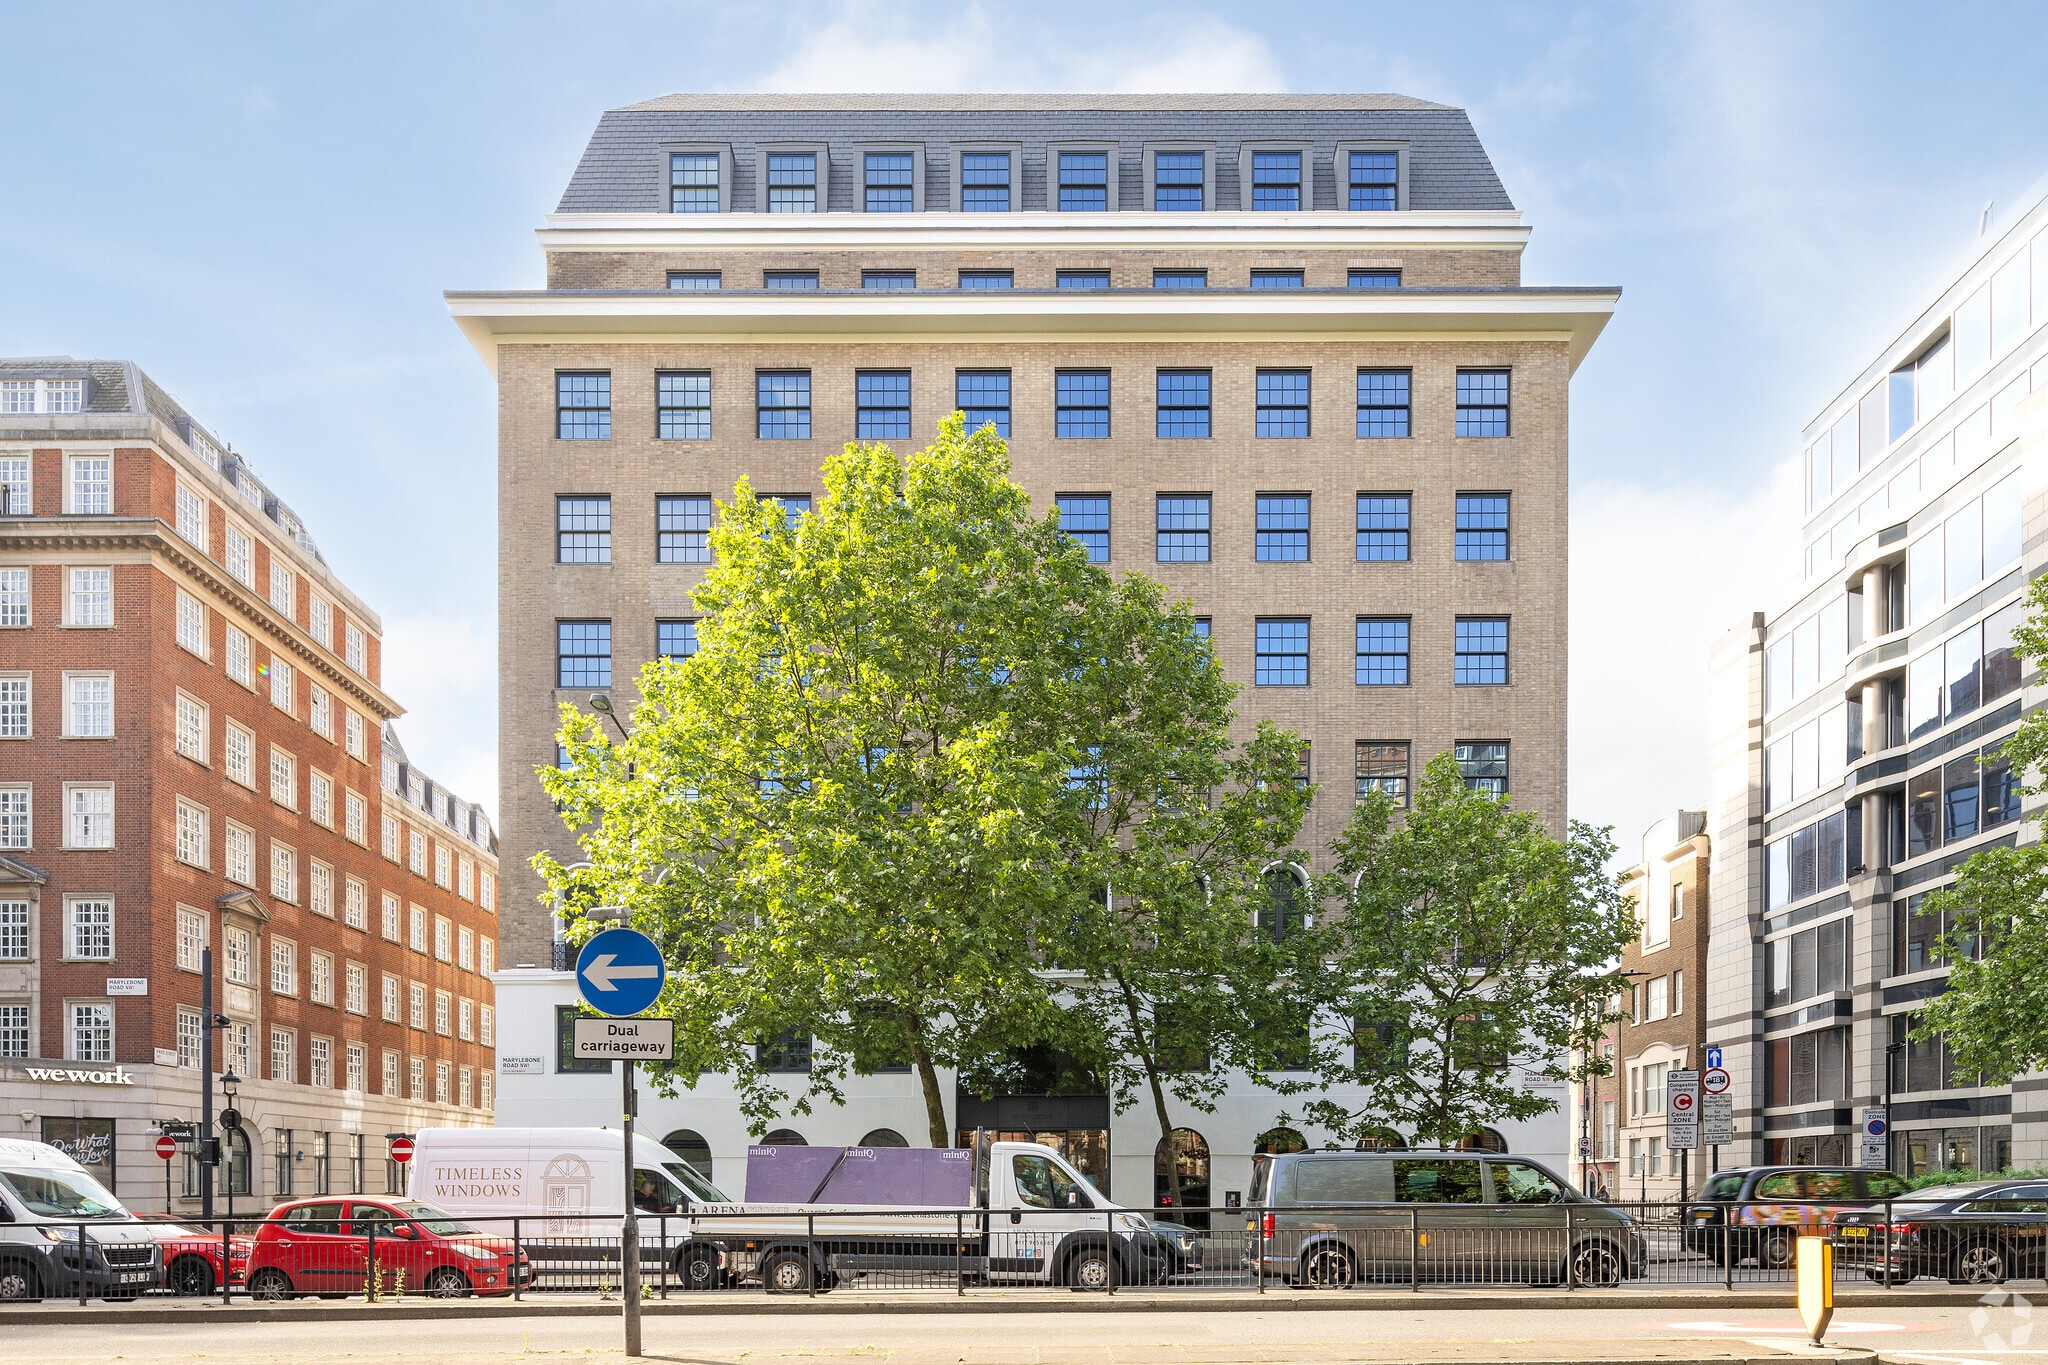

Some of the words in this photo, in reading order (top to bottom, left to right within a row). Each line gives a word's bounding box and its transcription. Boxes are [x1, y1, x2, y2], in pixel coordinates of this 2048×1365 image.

[608, 1024, 639, 1036] Dual
[581, 1040, 666, 1054] carriageway
[25, 1065, 135, 1085] wework
[750, 1148, 777, 1157] miniQ
[942, 1150, 970, 1160] miniQ
[434, 1168, 522, 1180] TIMELESS
[434, 1184, 520, 1197] WINDOWS
